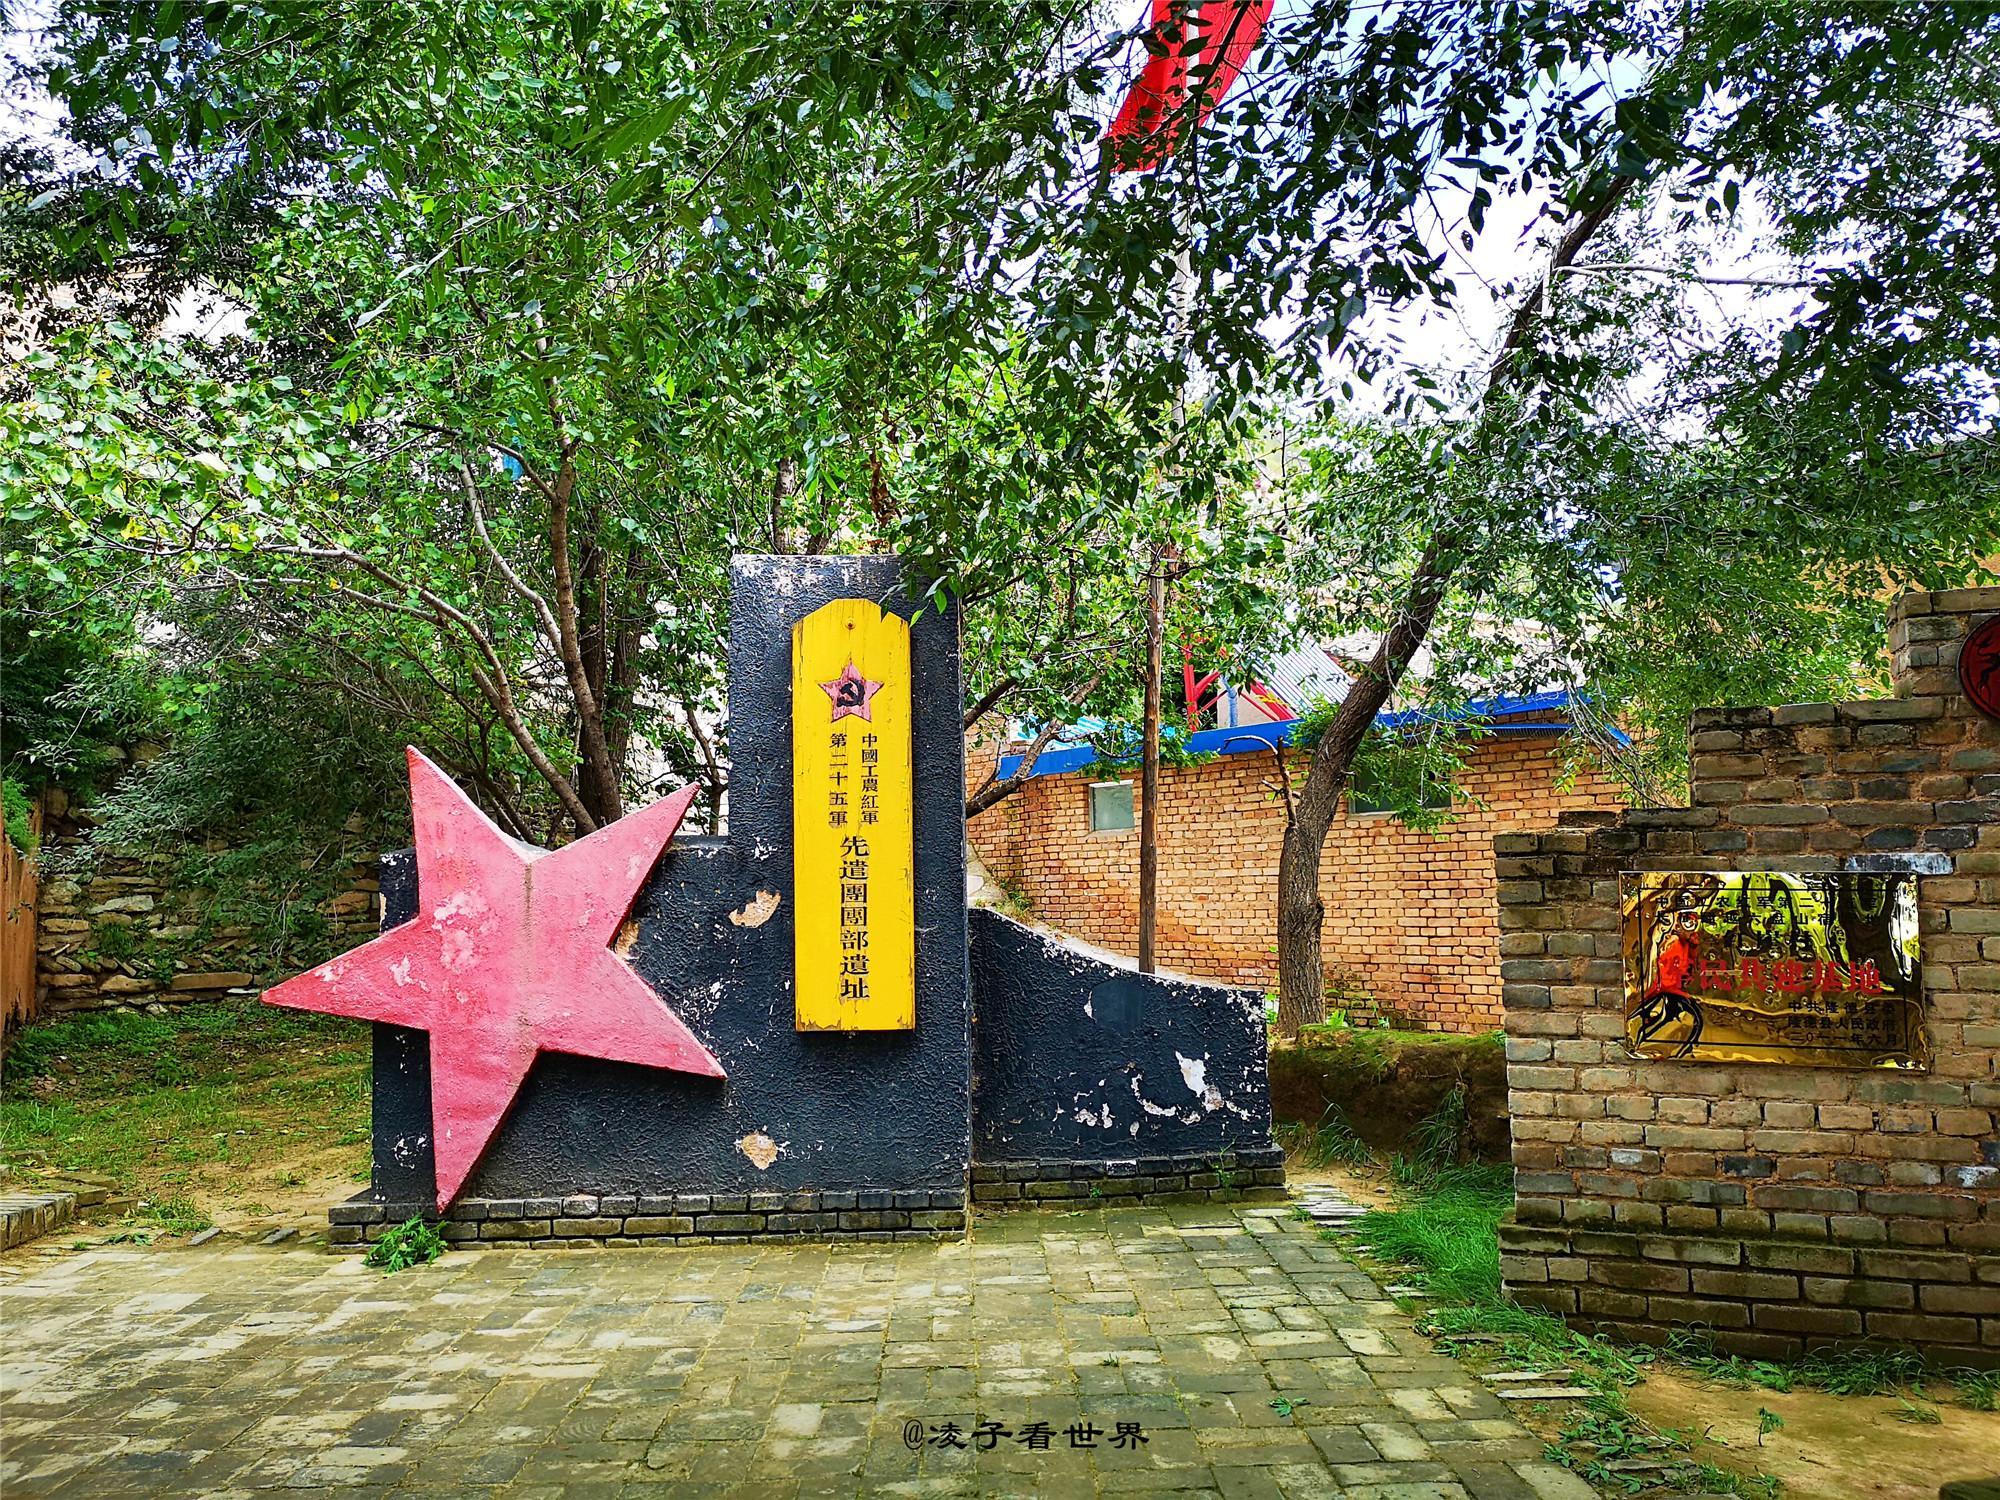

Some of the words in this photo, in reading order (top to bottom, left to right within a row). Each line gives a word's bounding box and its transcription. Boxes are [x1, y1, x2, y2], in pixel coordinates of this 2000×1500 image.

[829, 733, 848, 826] 第二十五軍
[861, 733, 879, 825] 中國工農紅軍
[839, 835, 870, 999] 先遣團團部遺址
